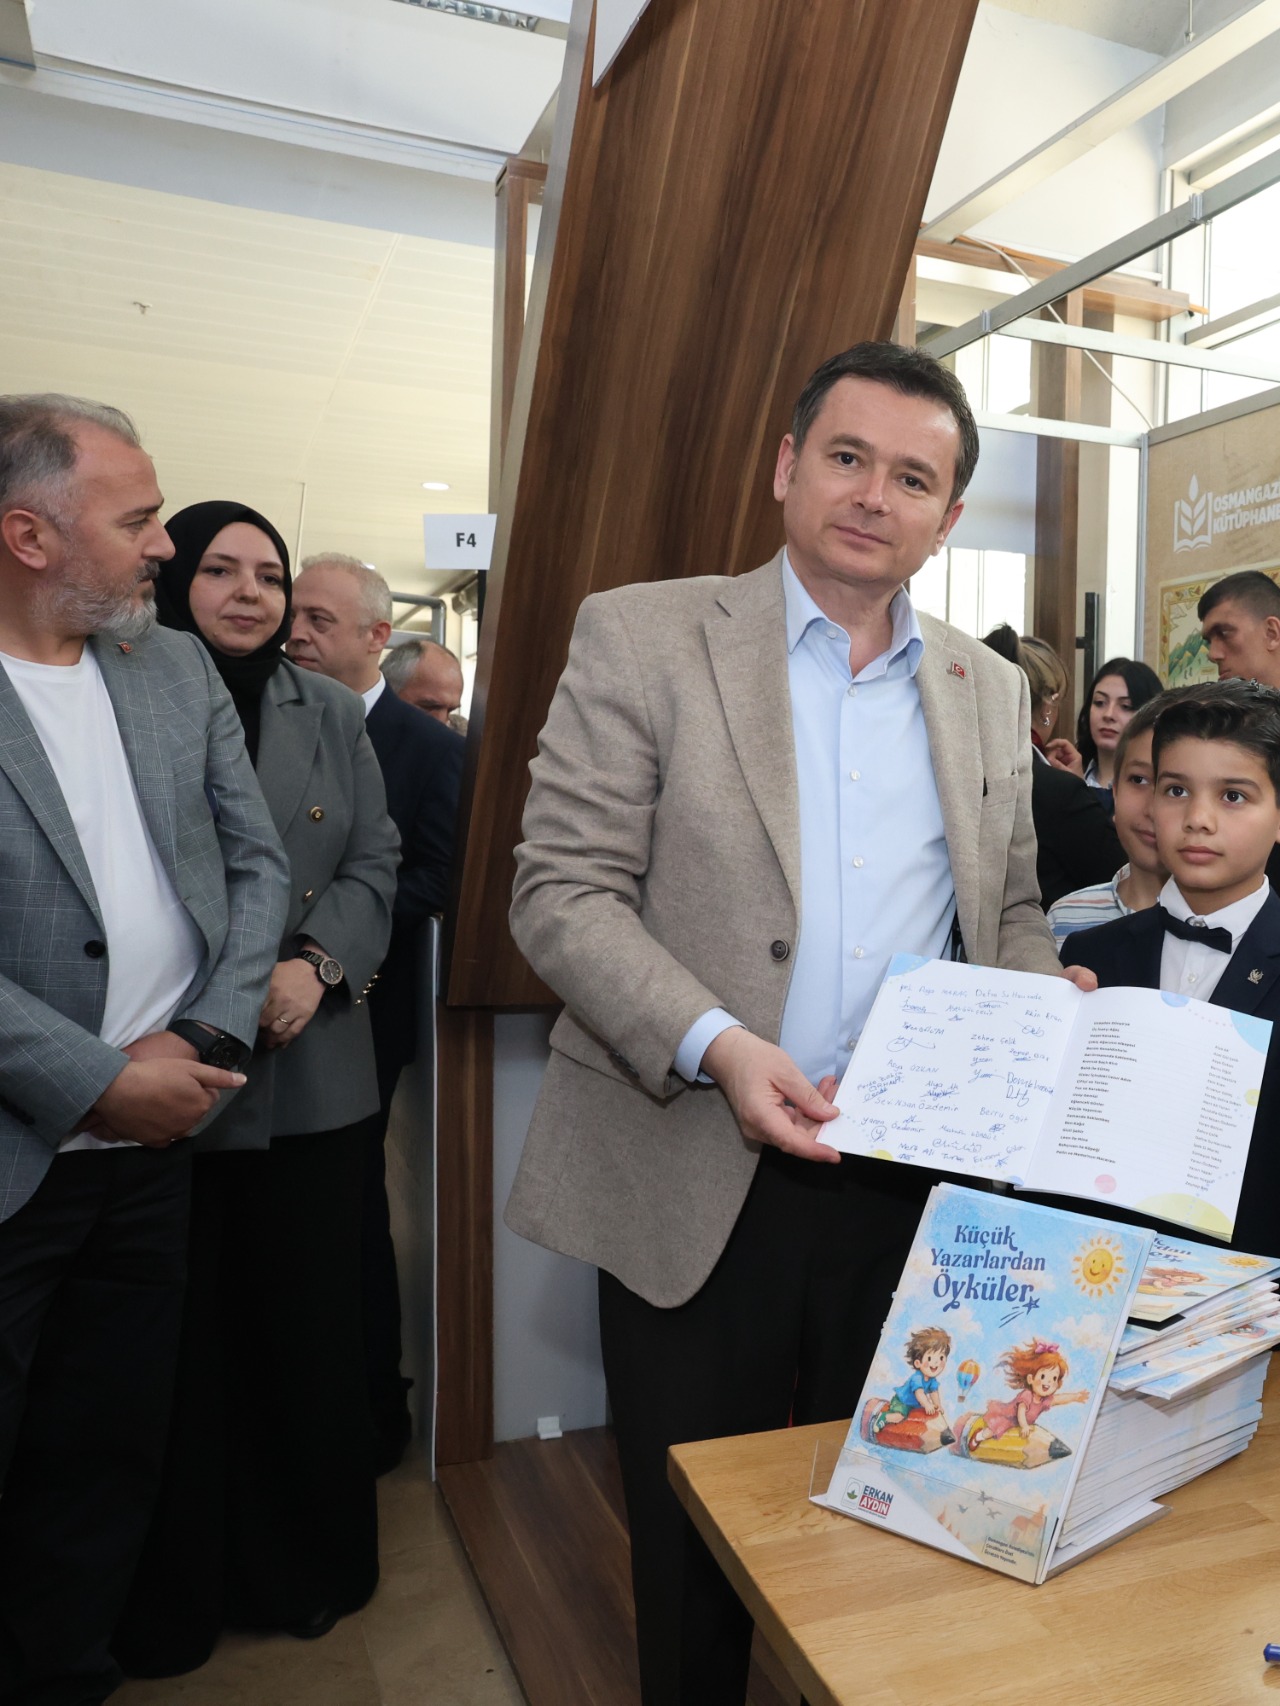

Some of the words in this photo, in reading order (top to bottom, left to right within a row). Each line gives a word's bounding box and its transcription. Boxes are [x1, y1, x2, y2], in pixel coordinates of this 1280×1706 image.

[455, 532, 477, 548] F4
[954, 1225, 1018, 1252] Küçük
[930, 1247, 1046, 1271] Yazarlardan
[933, 1268, 1035, 1313] Öyküler
[863, 1485, 894, 1504] ERKAN
[860, 1496, 889, 1515] AYDIN
